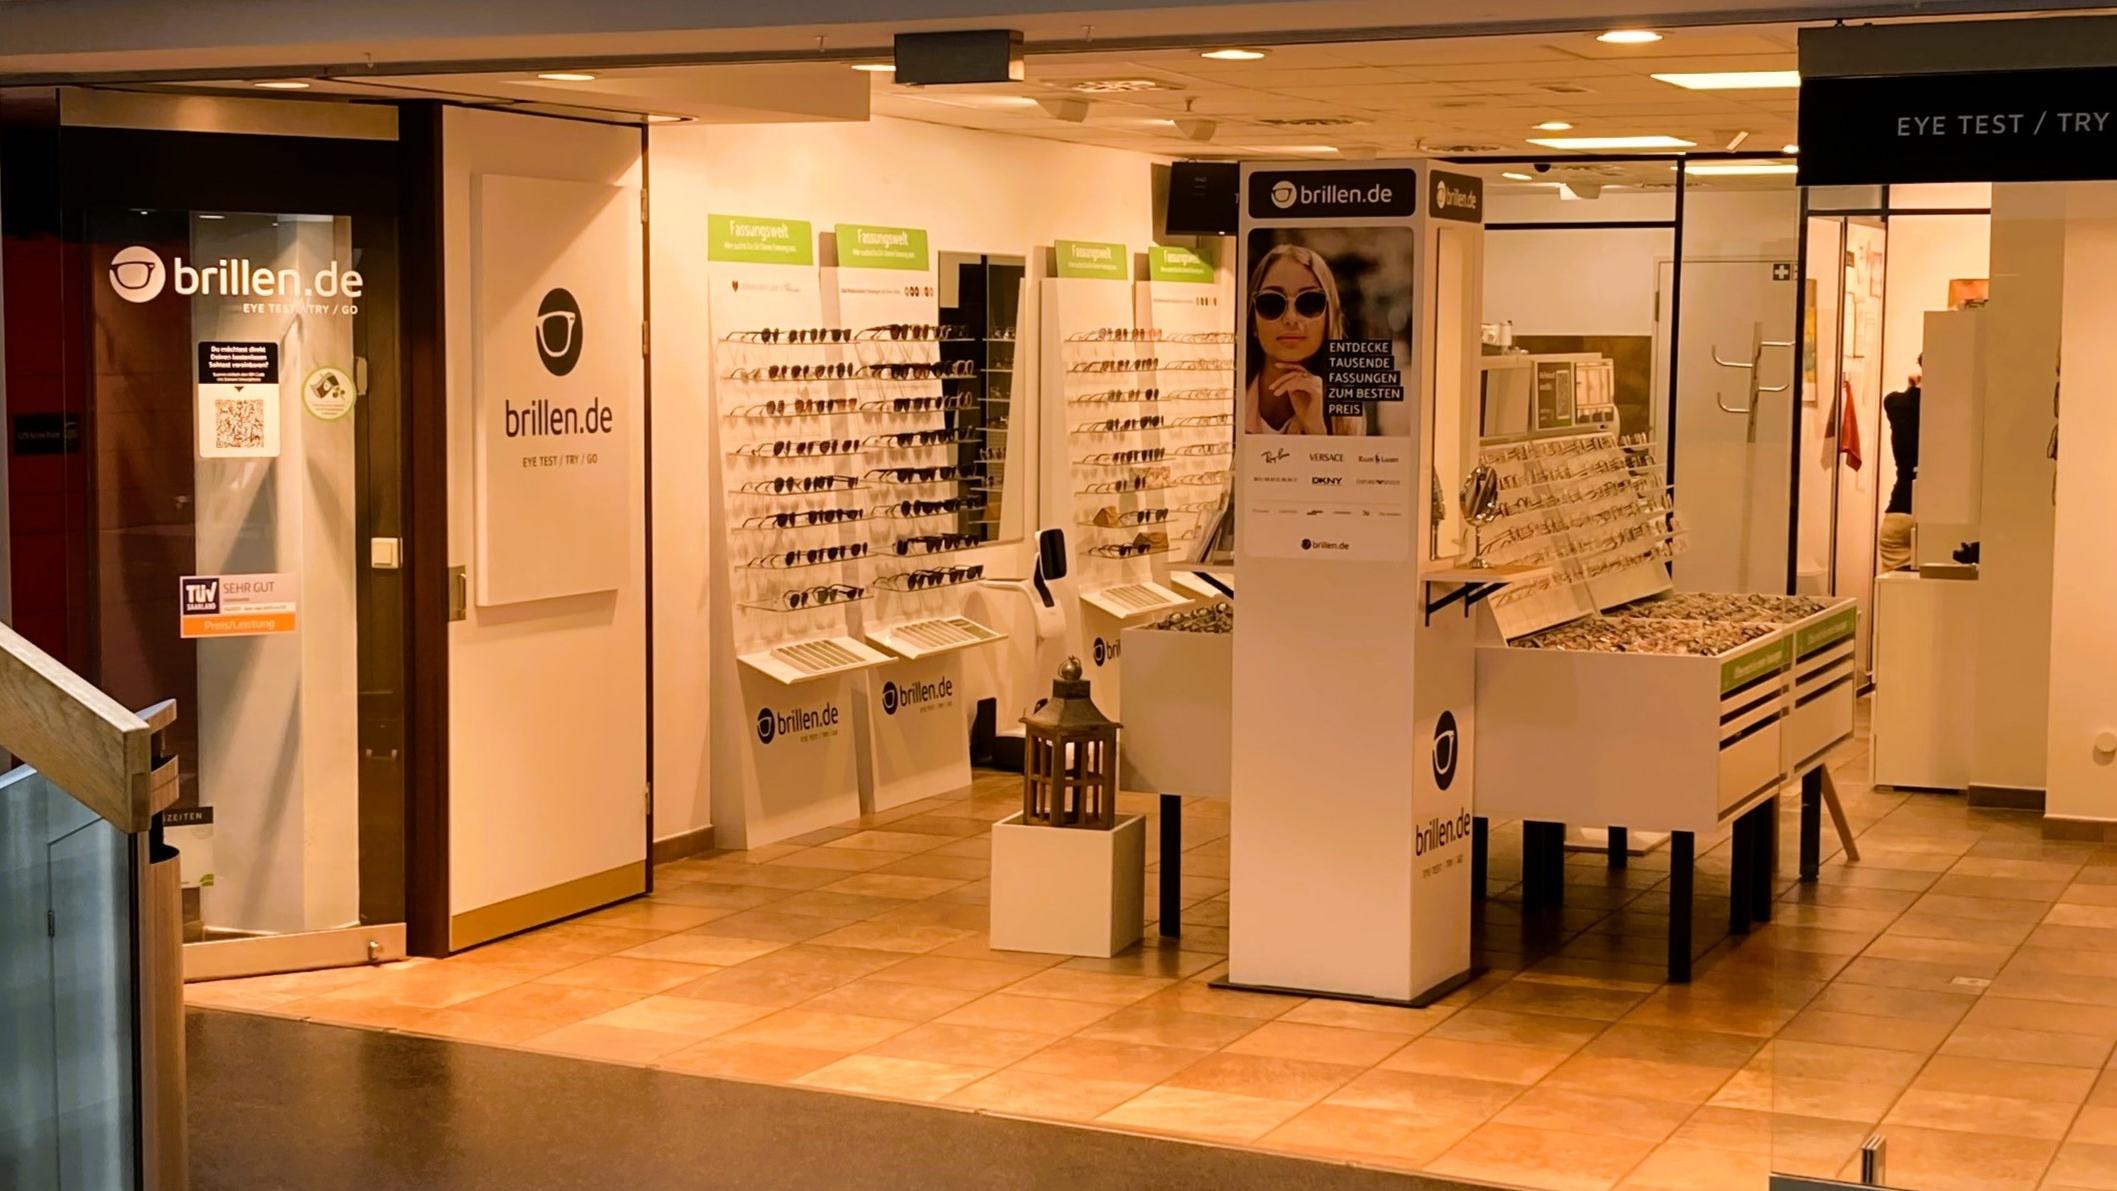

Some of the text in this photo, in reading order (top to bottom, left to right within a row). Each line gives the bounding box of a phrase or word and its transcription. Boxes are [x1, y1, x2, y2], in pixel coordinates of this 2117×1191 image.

[1896, 115, 1946, 136] EYE
[1957, 114, 2024, 135] TEST
[2057, 112, 2111, 133] TRY
[1300, 184, 1393, 204] brillen.de
[174, 256, 364, 298] brillen.de
[243, 303, 265, 314] EYE
[309, 304, 330, 314] TRY
[341, 305, 359, 315] GO
[1329, 342, 1389, 353] ENTDECKE
[1329, 357, 1391, 368] TAUSENDE
[1328, 372, 1398, 384] FASSUNGEN
[1328, 387, 1401, 399] ZUM BESTEN
[1328, 403, 1361, 415] PREIS
[505, 396, 613, 438] brillen.de
[522, 456, 537, 468] EYE
[540, 455, 558, 467] TEST
[565, 454, 579, 465] TRY
[586, 453, 598, 464] GO
[1309, 452, 1344, 462] VERSACE
[1311, 477, 1343, 485] DKNY
[1312, 541, 1350, 550] brillen.de
[185, 581, 218, 603] TÜV
[223, 581, 275, 594] SEHR GUT
[899, 675, 953, 707] brillen.de
[777, 701, 839, 736] brillen.de
[163, 812, 203, 823] ZEITEN
[1415, 806, 1471, 857] brillen.de
